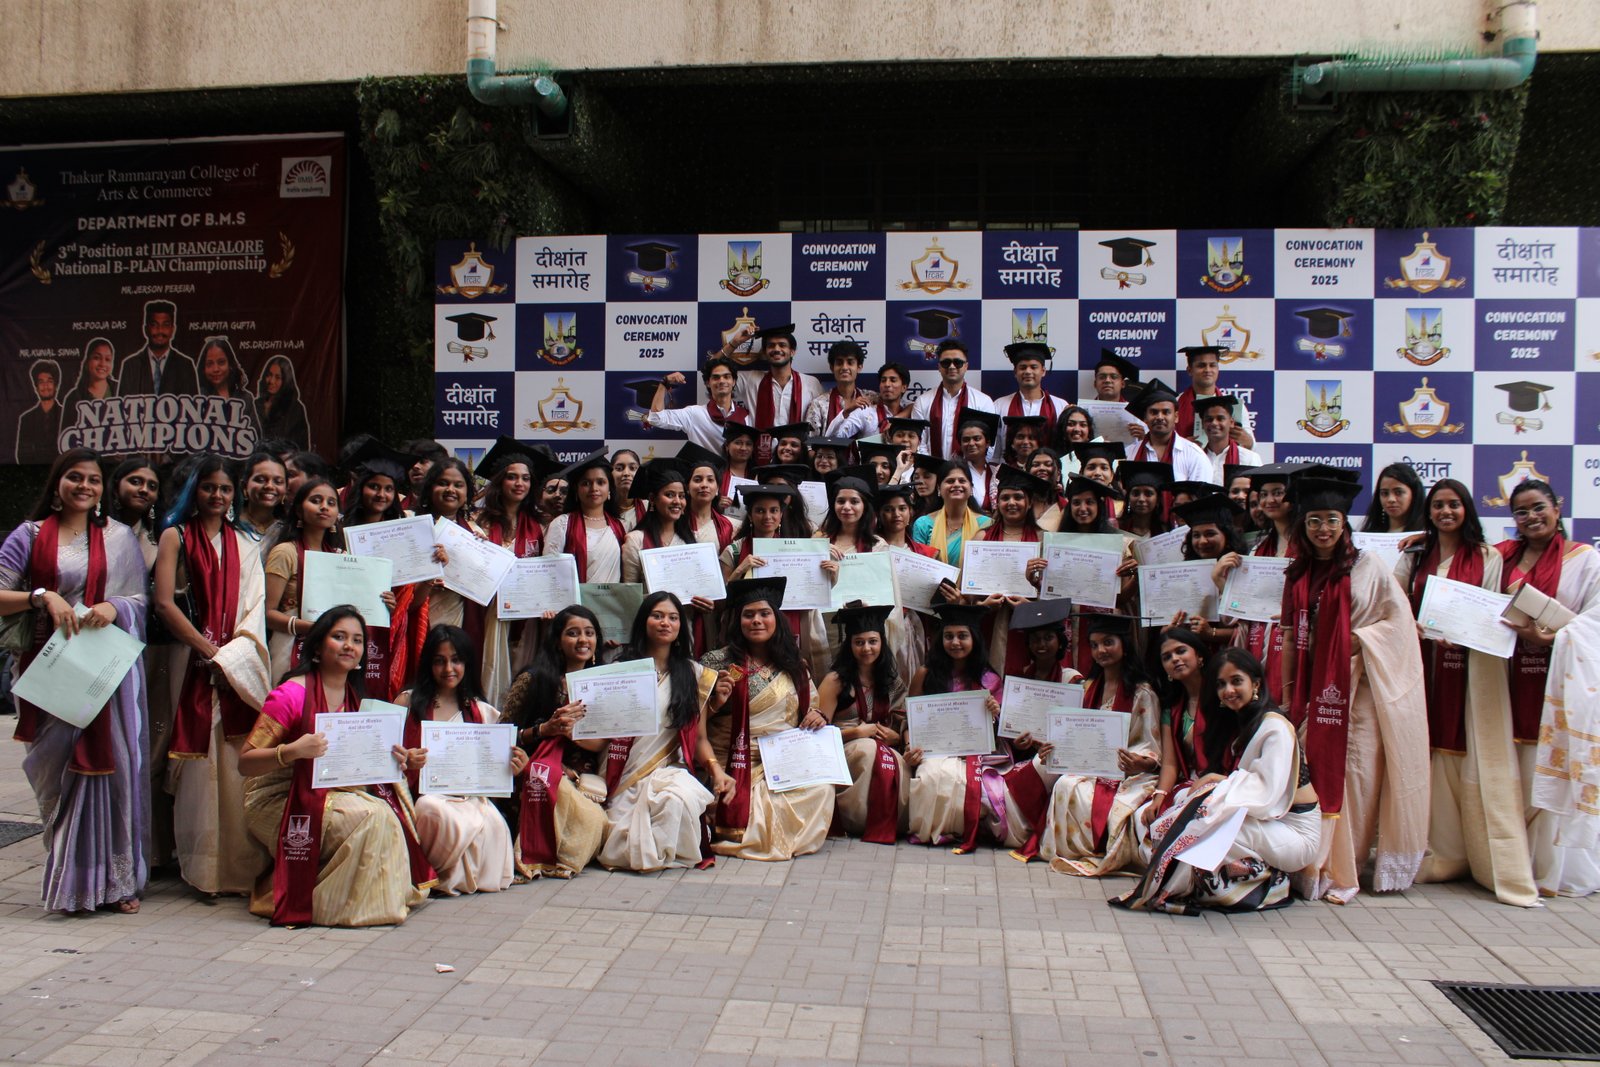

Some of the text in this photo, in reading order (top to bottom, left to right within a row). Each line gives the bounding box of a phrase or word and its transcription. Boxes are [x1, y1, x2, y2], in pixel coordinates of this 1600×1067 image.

[59, 164, 258, 185] Thakur Ramnarayan College of
[97, 185, 212, 201] Arts & Commerce
[78, 212, 246, 230] DEPARTMENT OF B.M.S
[58, 240, 264, 259] 3rd Position at IIM BANGALORE
[802, 244, 876, 255] CONVOCATION
[1002, 240, 1059, 262] दीक्षांत
[1285, 240, 1363, 252] CONVOCATION
[1496, 238, 1556, 260] दीक्षांत
[534, 246, 588, 269] दीक्षांत
[1294, 258, 1356, 269] CEREMONY
[54, 256, 266, 276] National B-PLAN Championship
[810, 260, 869, 272] CEREMONY
[998, 262, 1062, 288] समारोह
[1492, 260, 1560, 287] समारोह
[532, 268, 591, 292] समारोह
[826, 278, 852, 289] 2025
[1310, 274, 1339, 286] 2025
[164, 284, 196, 294] PEREIRA
[616, 314, 688, 326] CONVOCATION
[811, 312, 866, 334] दीक्षांत
[1088, 312, 1166, 324] CONVOCATION
[1485, 312, 1566, 324] CONVOCATION
[110, 320, 127, 330] DAS
[230, 320, 256, 330] GUPTA
[623, 332, 680, 342] CEREMONY
[1097, 329, 1158, 341] CEREMONY
[1494, 330, 1558, 342] CEREMONY
[284, 340, 304, 349] VAJA
[639, 348, 665, 360] 2025
[1114, 346, 1142, 358] 2025
[1510, 347, 1540, 359] 2025
[446, 382, 497, 406] दीक्षांत
[77, 395, 250, 430] NATIONAL
[442, 406, 500, 428] समारोह
[60, 422, 256, 456] CHAMPIONS
[1316, 716, 1342, 726] समारंभ
